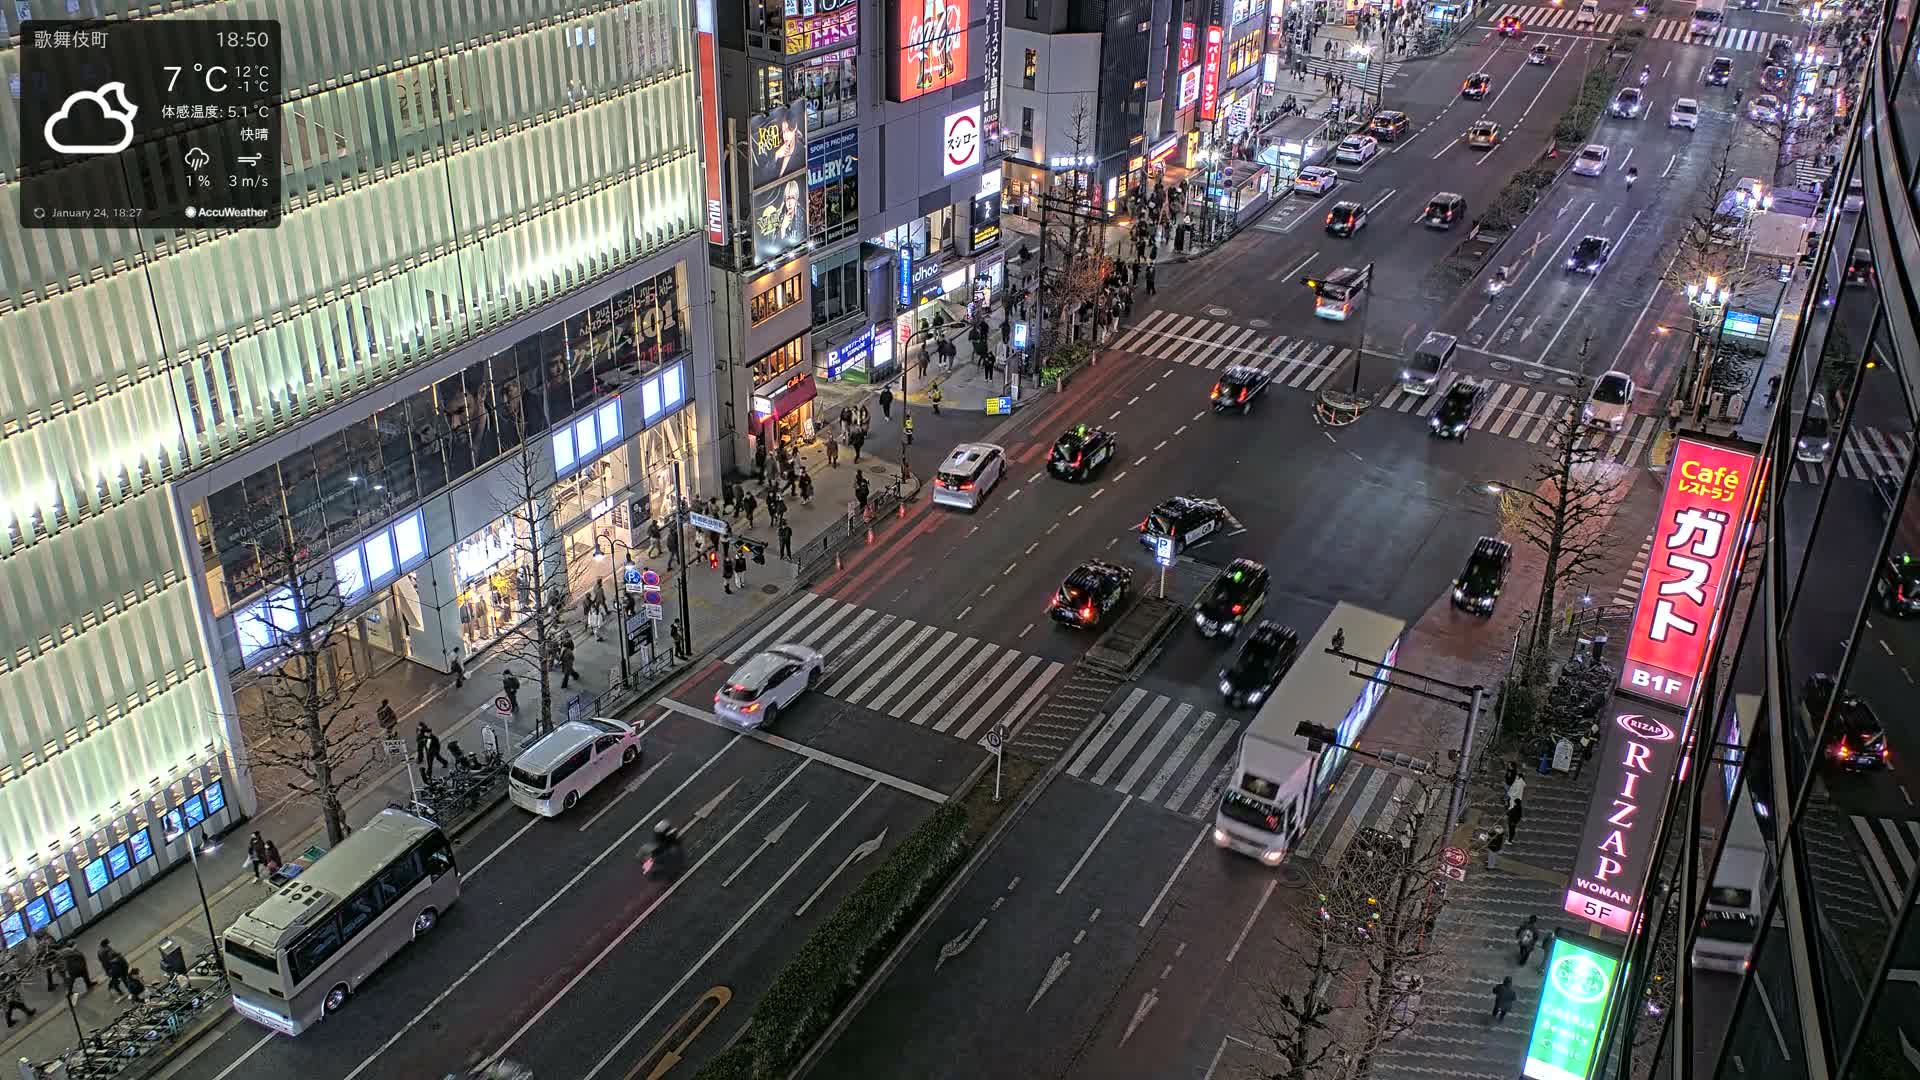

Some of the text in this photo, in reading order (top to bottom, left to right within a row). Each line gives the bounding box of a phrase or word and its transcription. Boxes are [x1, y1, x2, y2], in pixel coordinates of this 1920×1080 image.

[1204, 45, 1219, 110] バーガーキング
[947, 133, 978, 150] スシロー
[709, 199, 721, 232] MUJI
[912, 263, 938, 284] dhoc
[1681, 460, 1739, 490] Café
[1678, 479, 1735, 501] レストラン
[1649, 508, 1730, 643] ガスト
[1631, 668, 1682, 695] B1F
[1631, 719, 1661, 735] RIZAP
[1595, 741, 1652, 880] RIZAP
[1577, 878, 1632, 905] WOMAN
[1584, 902, 1613, 919] 5F
